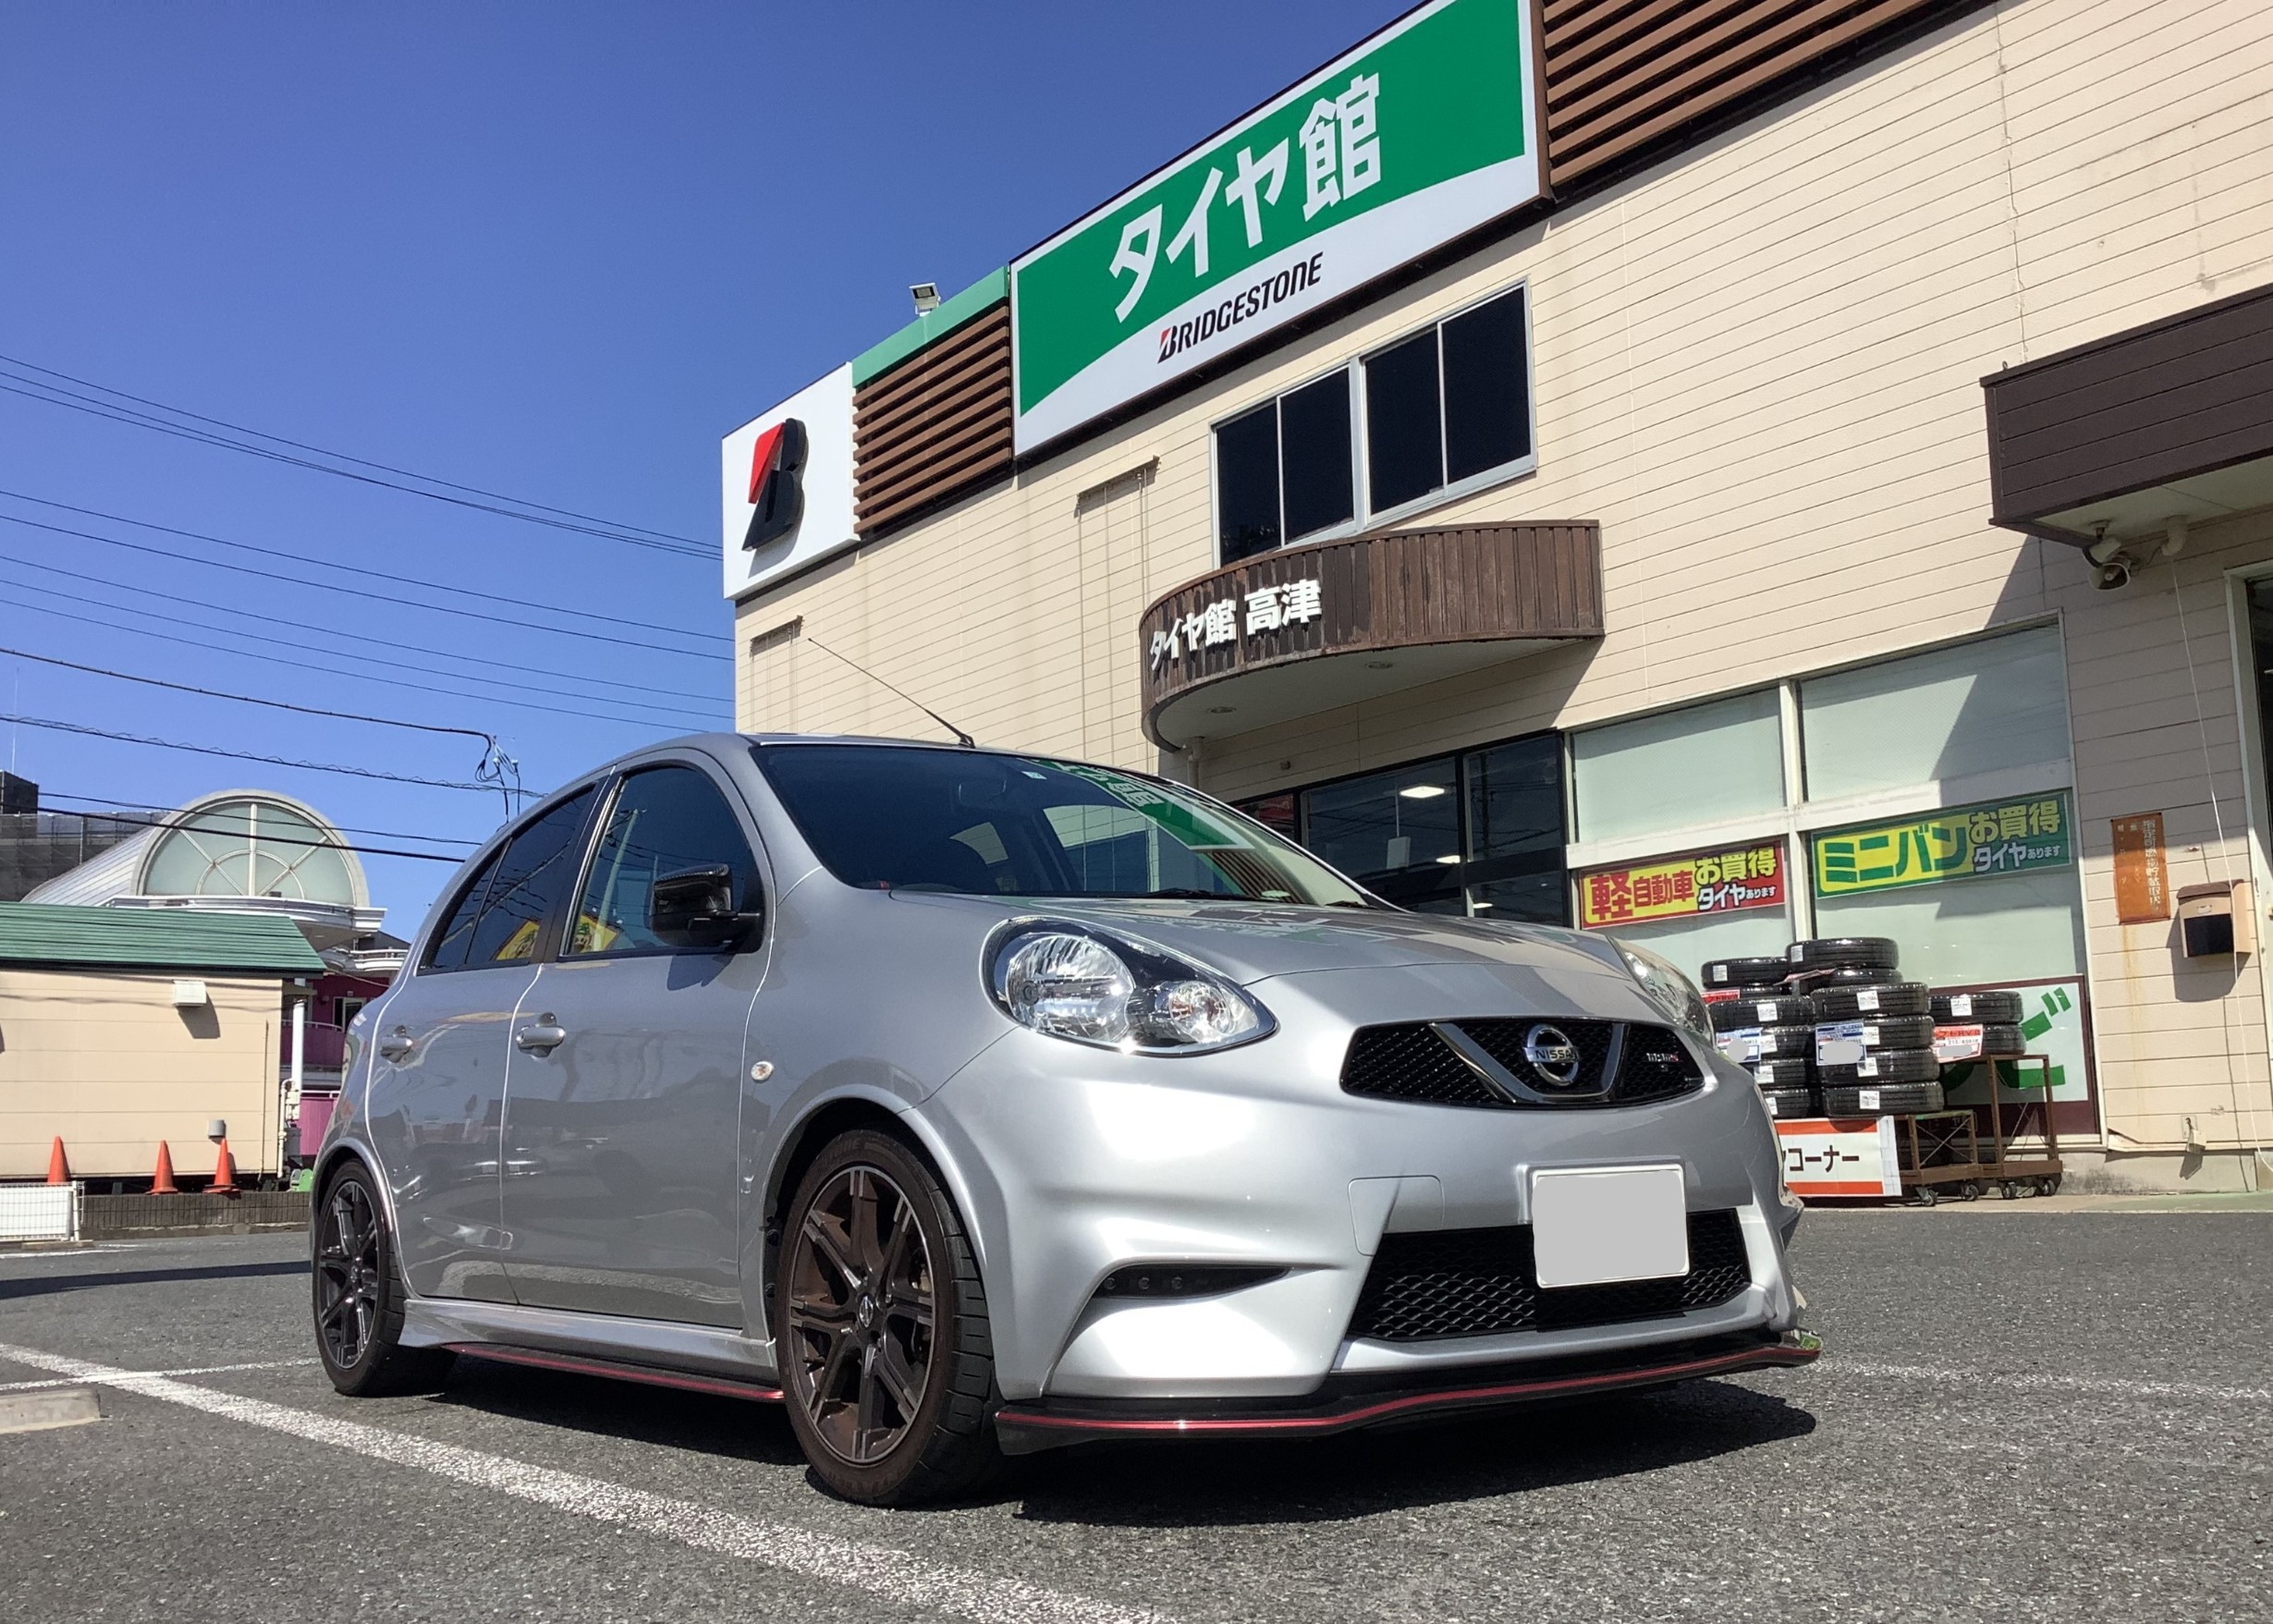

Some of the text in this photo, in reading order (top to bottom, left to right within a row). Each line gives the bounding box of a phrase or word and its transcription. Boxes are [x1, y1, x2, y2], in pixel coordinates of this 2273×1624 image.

[1109, 72, 1382, 323] タイヤ館
[1157, 251, 1324, 364] BRIDGESTONE
[1149, 578, 1322, 671] タイヤ館 高津
[1970, 800, 2060, 844] お買得
[1694, 846, 1777, 885] お買得
[1824, 824, 1968, 884] ミニバン
[1973, 843, 2062, 873] タイヤあります
[1589, 871, 1694, 922] 軽自動車
[1698, 885, 1777, 911] タイヤあります
[1534, 1049, 1579, 1062] NISSAN
[1782, 1144, 1860, 1172] コーナー
